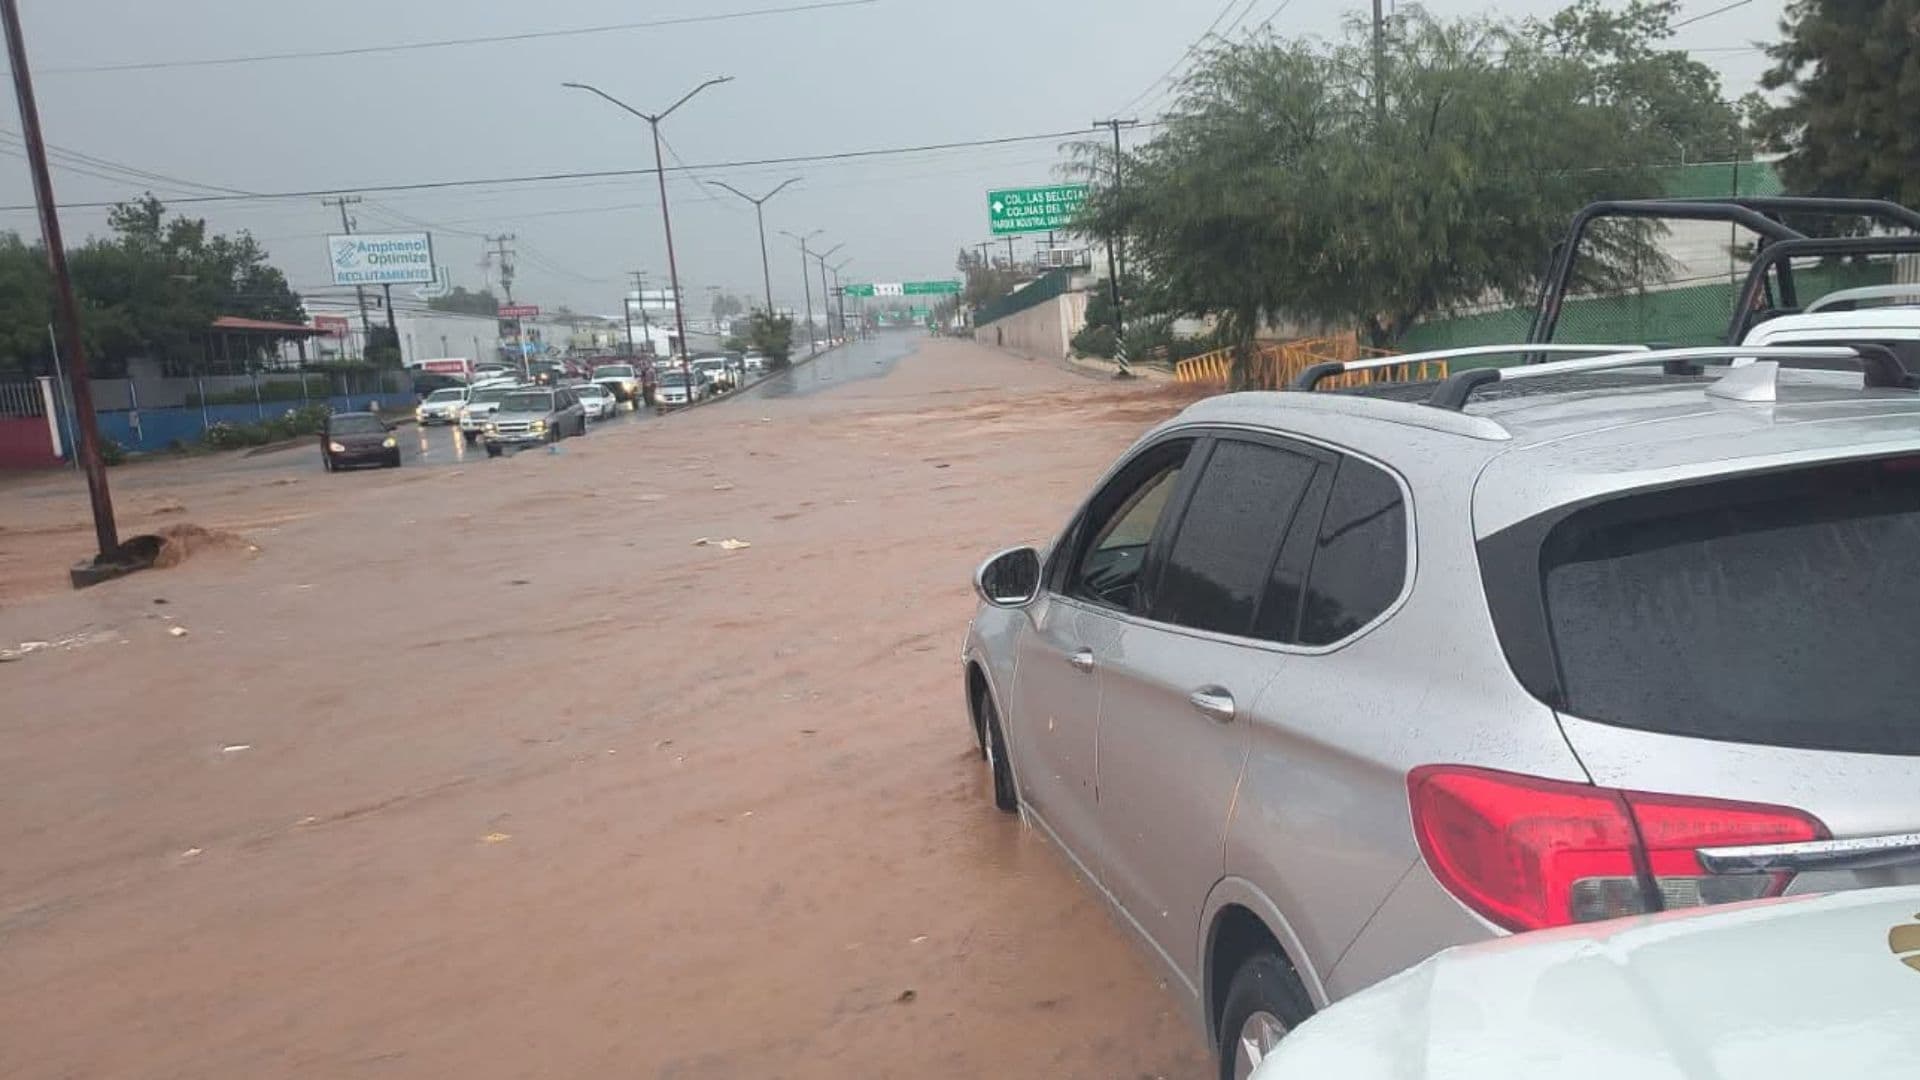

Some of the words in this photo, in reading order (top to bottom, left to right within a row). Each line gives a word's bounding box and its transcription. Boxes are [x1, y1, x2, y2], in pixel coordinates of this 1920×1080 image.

[1005, 193, 1024, 205] COL.
[1026, 191, 1043, 203] LAS
[1006, 204, 1044, 217] COLINAS
[1046, 202, 1061, 215] DEL
[357, 240, 426, 254] Amphenol
[367, 252, 428, 266] Optimize
[337, 269, 429, 281] RECLUTAMIENTO
